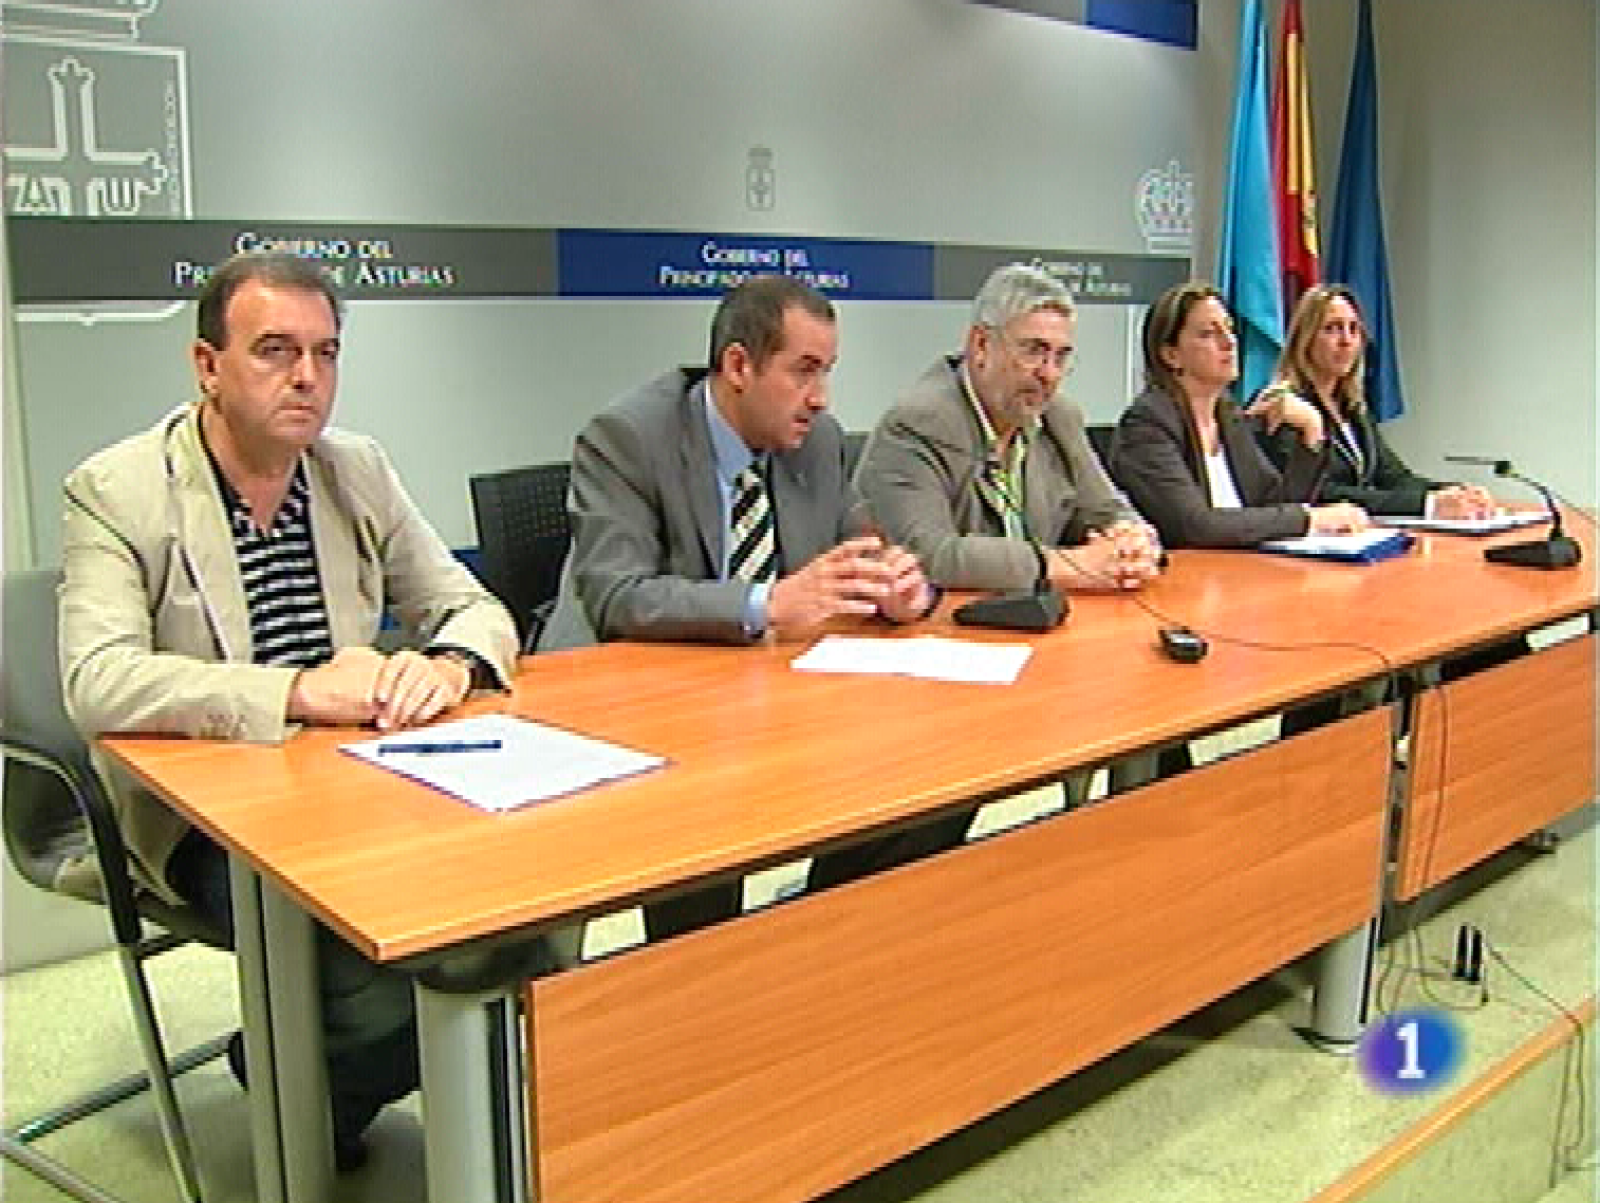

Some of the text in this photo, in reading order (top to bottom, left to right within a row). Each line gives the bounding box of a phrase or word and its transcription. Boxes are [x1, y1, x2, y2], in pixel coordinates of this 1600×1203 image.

[235, 231, 393, 259] GOBIERNO DEL
[355, 261, 454, 288] ASTURIAS
